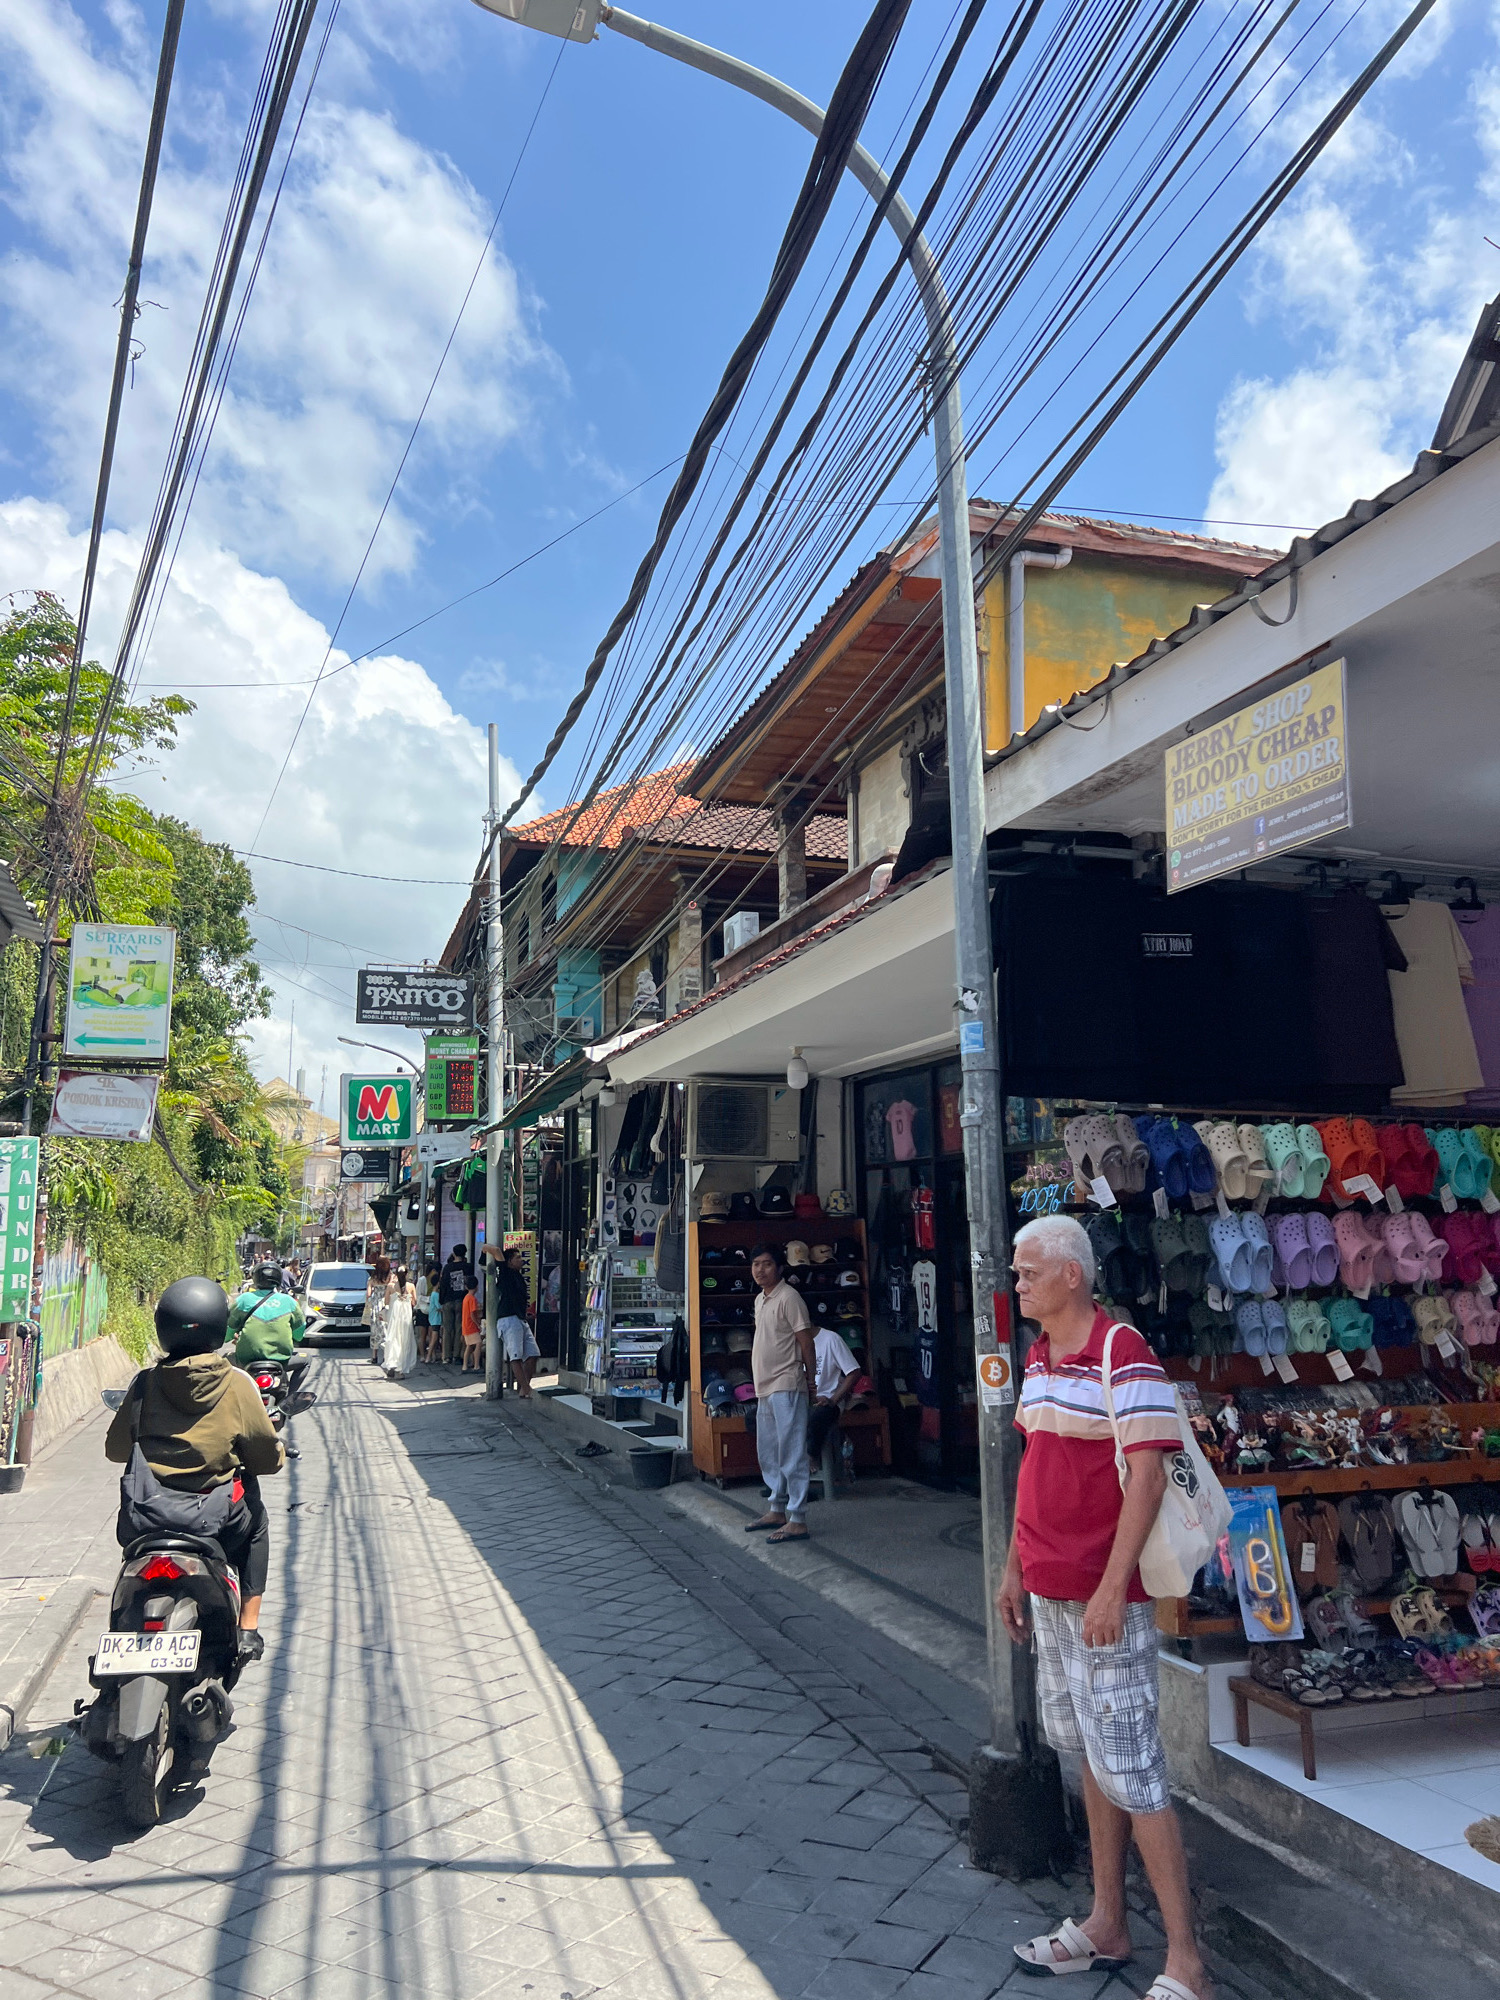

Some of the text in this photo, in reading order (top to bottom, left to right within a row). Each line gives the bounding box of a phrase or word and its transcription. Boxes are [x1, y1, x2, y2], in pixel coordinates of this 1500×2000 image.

[1173, 704, 1336, 805] BLOODY CHEAP
[1172, 786, 1227, 832] MADE
[1232, 773, 1259, 804] TO
[1264, 736, 1341, 790] ORDER
[1196, 816, 1226, 837] WORRY
[1226, 809, 1242, 824] FOR
[1243, 801, 1259, 817] THE
[1261, 792, 1285, 812] PRICE
[1312, 768, 1341, 788] CHEAP
[85, 931, 163, 945] SURFARIS
[108, 943, 139, 955] INN
[365, 986, 467, 1011] TATTOO
[430, 1047, 450, 1055] MONEY
[62, 1092, 146, 1110] PONDOK KRISHNA
[356, 1122, 400, 1135] MART
[10, 1144, 33, 1316] LAUNDRY
[504, 1242, 533, 1250] Bubbles
[102, 1637, 122, 1653] DK
[125, 1636, 163, 1653] 2118
